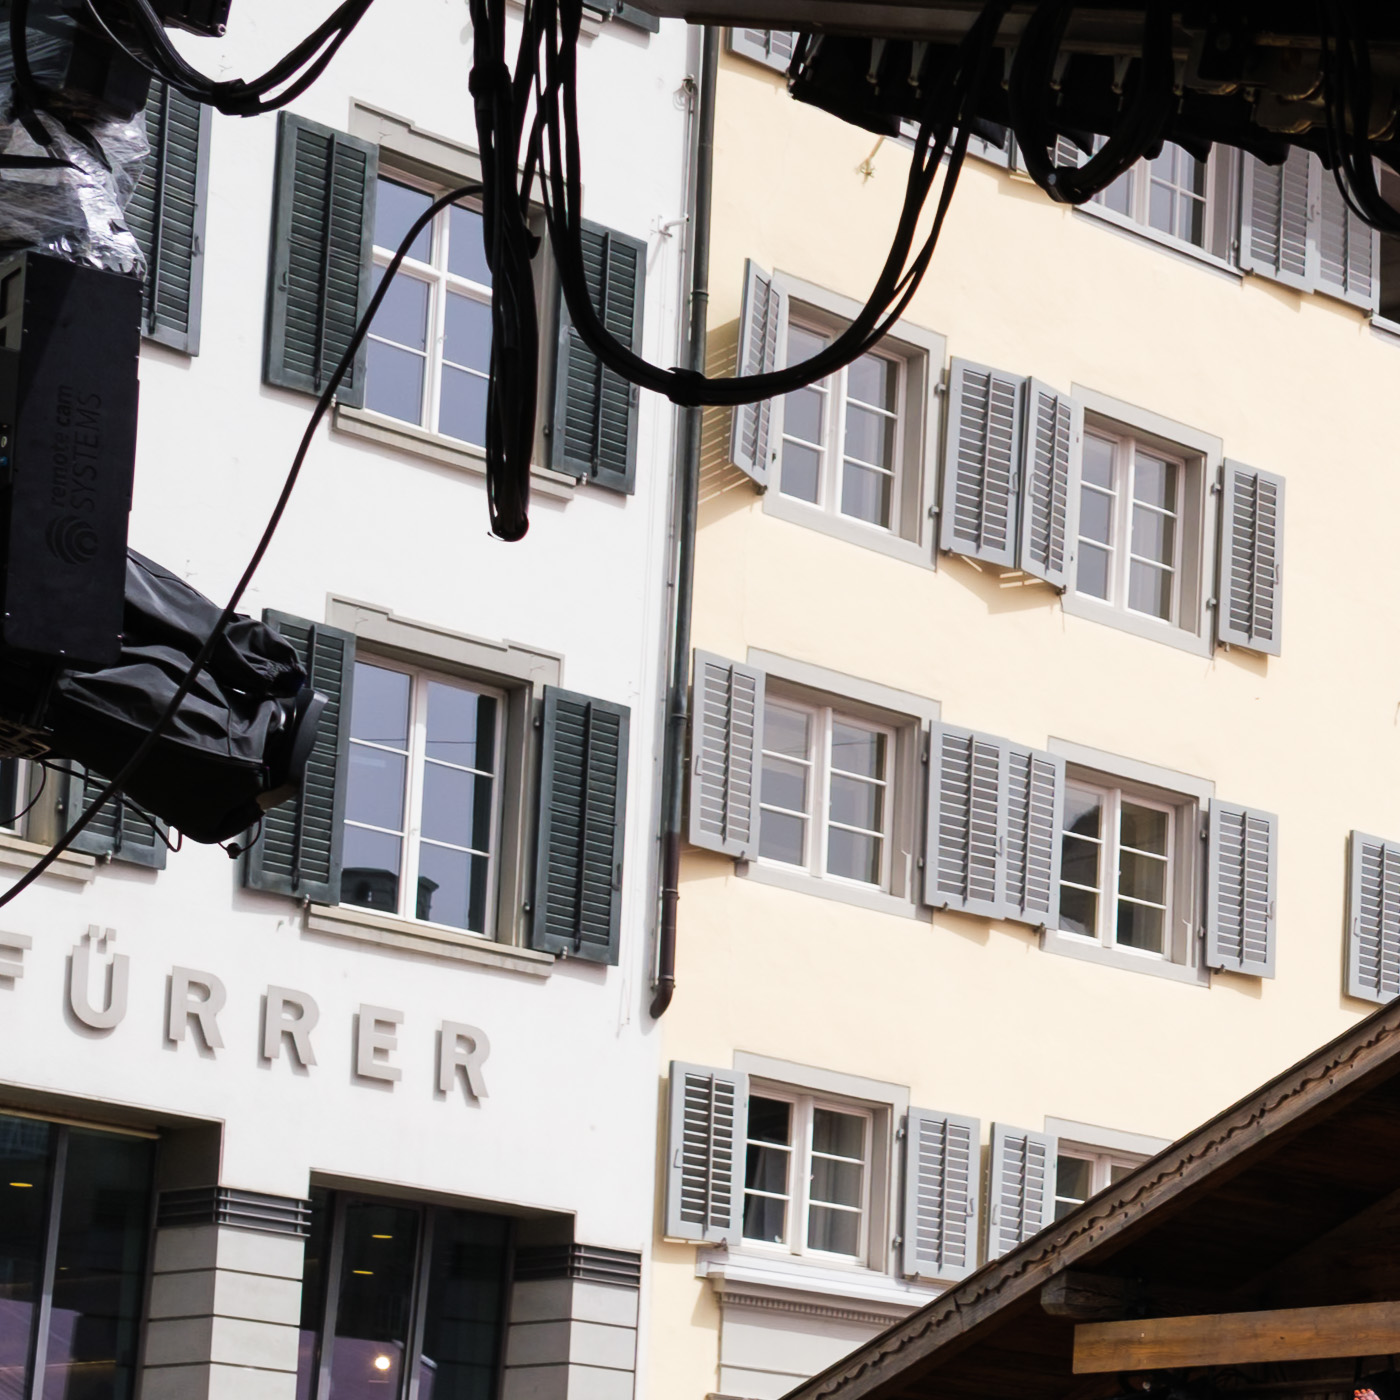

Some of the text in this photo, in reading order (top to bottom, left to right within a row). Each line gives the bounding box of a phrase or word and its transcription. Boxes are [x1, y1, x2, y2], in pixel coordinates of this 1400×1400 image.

[50, 383, 74, 509] remote cam
[69, 392, 103, 514] SYSTEMS
